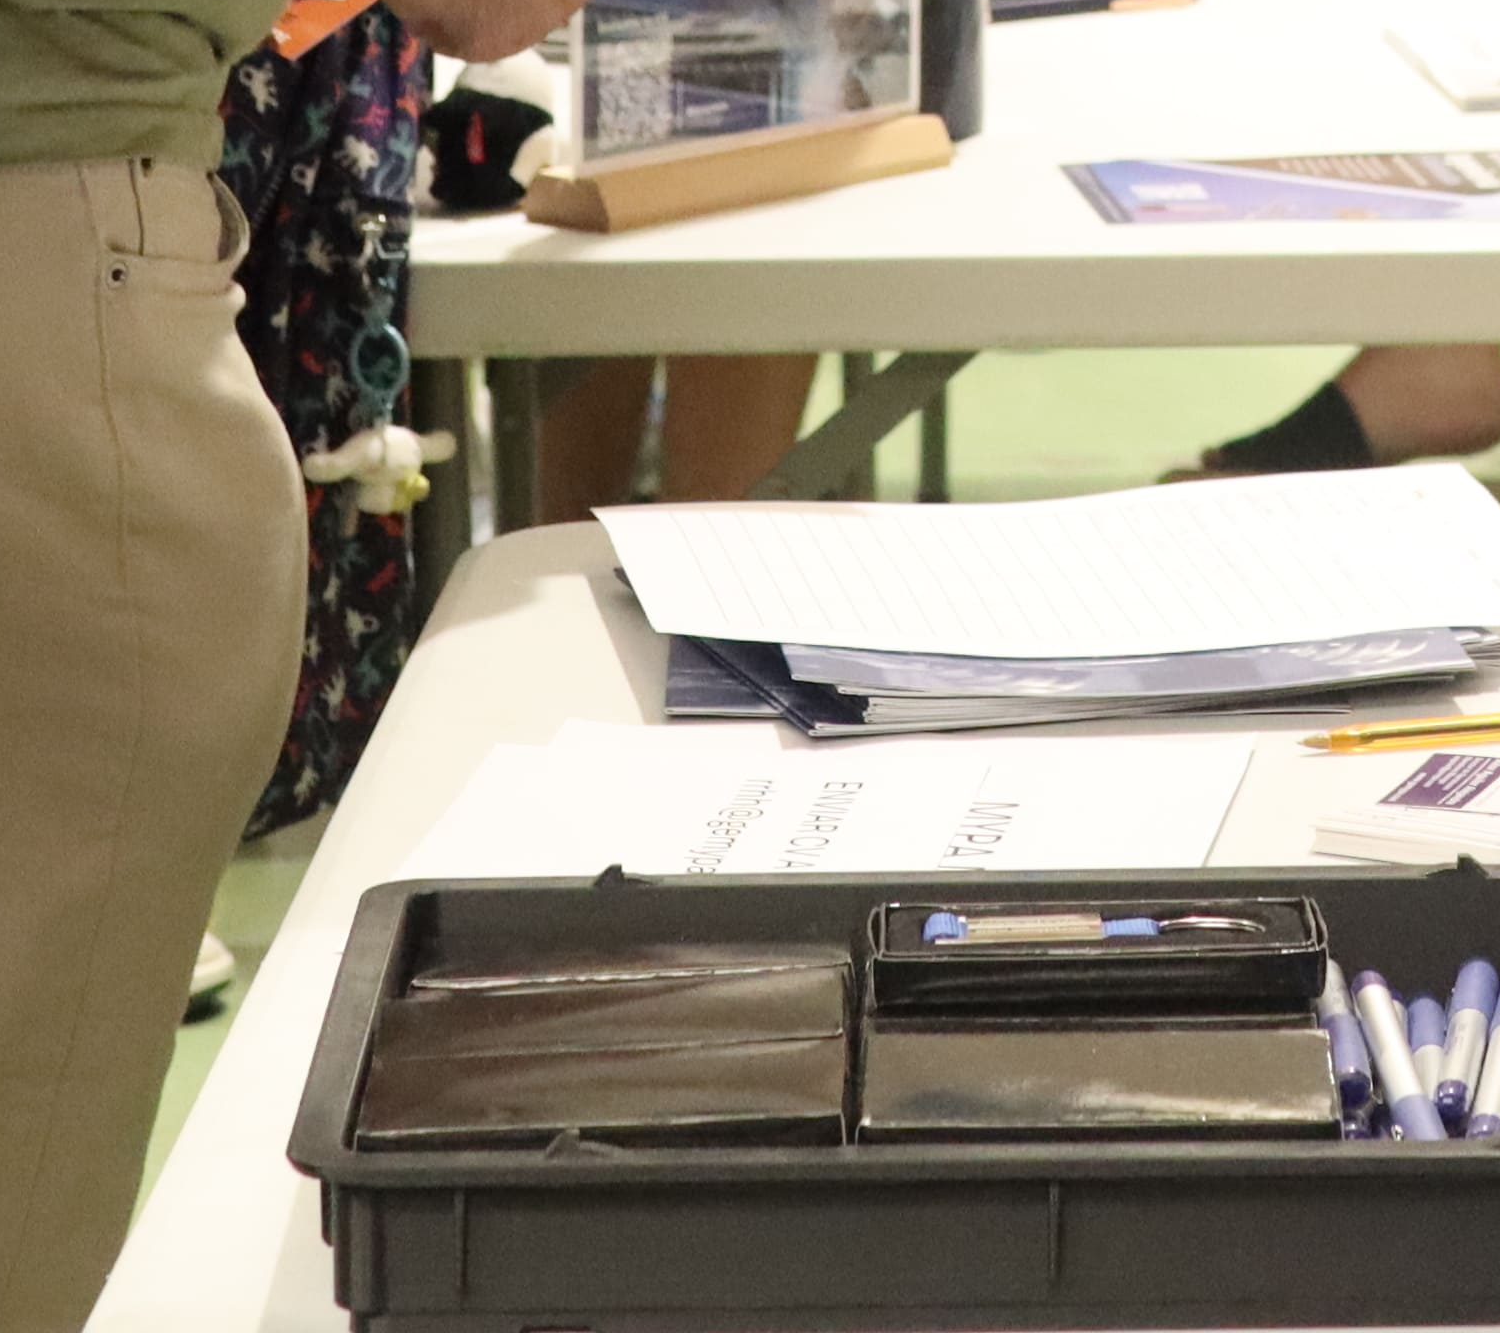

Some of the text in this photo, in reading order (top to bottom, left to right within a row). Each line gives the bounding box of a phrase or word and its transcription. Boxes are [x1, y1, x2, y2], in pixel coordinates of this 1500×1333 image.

[799, 782, 865, 833] ENVIAR
[943, 801, 1020, 858] MYPA
[785, 836, 831, 856] CV
